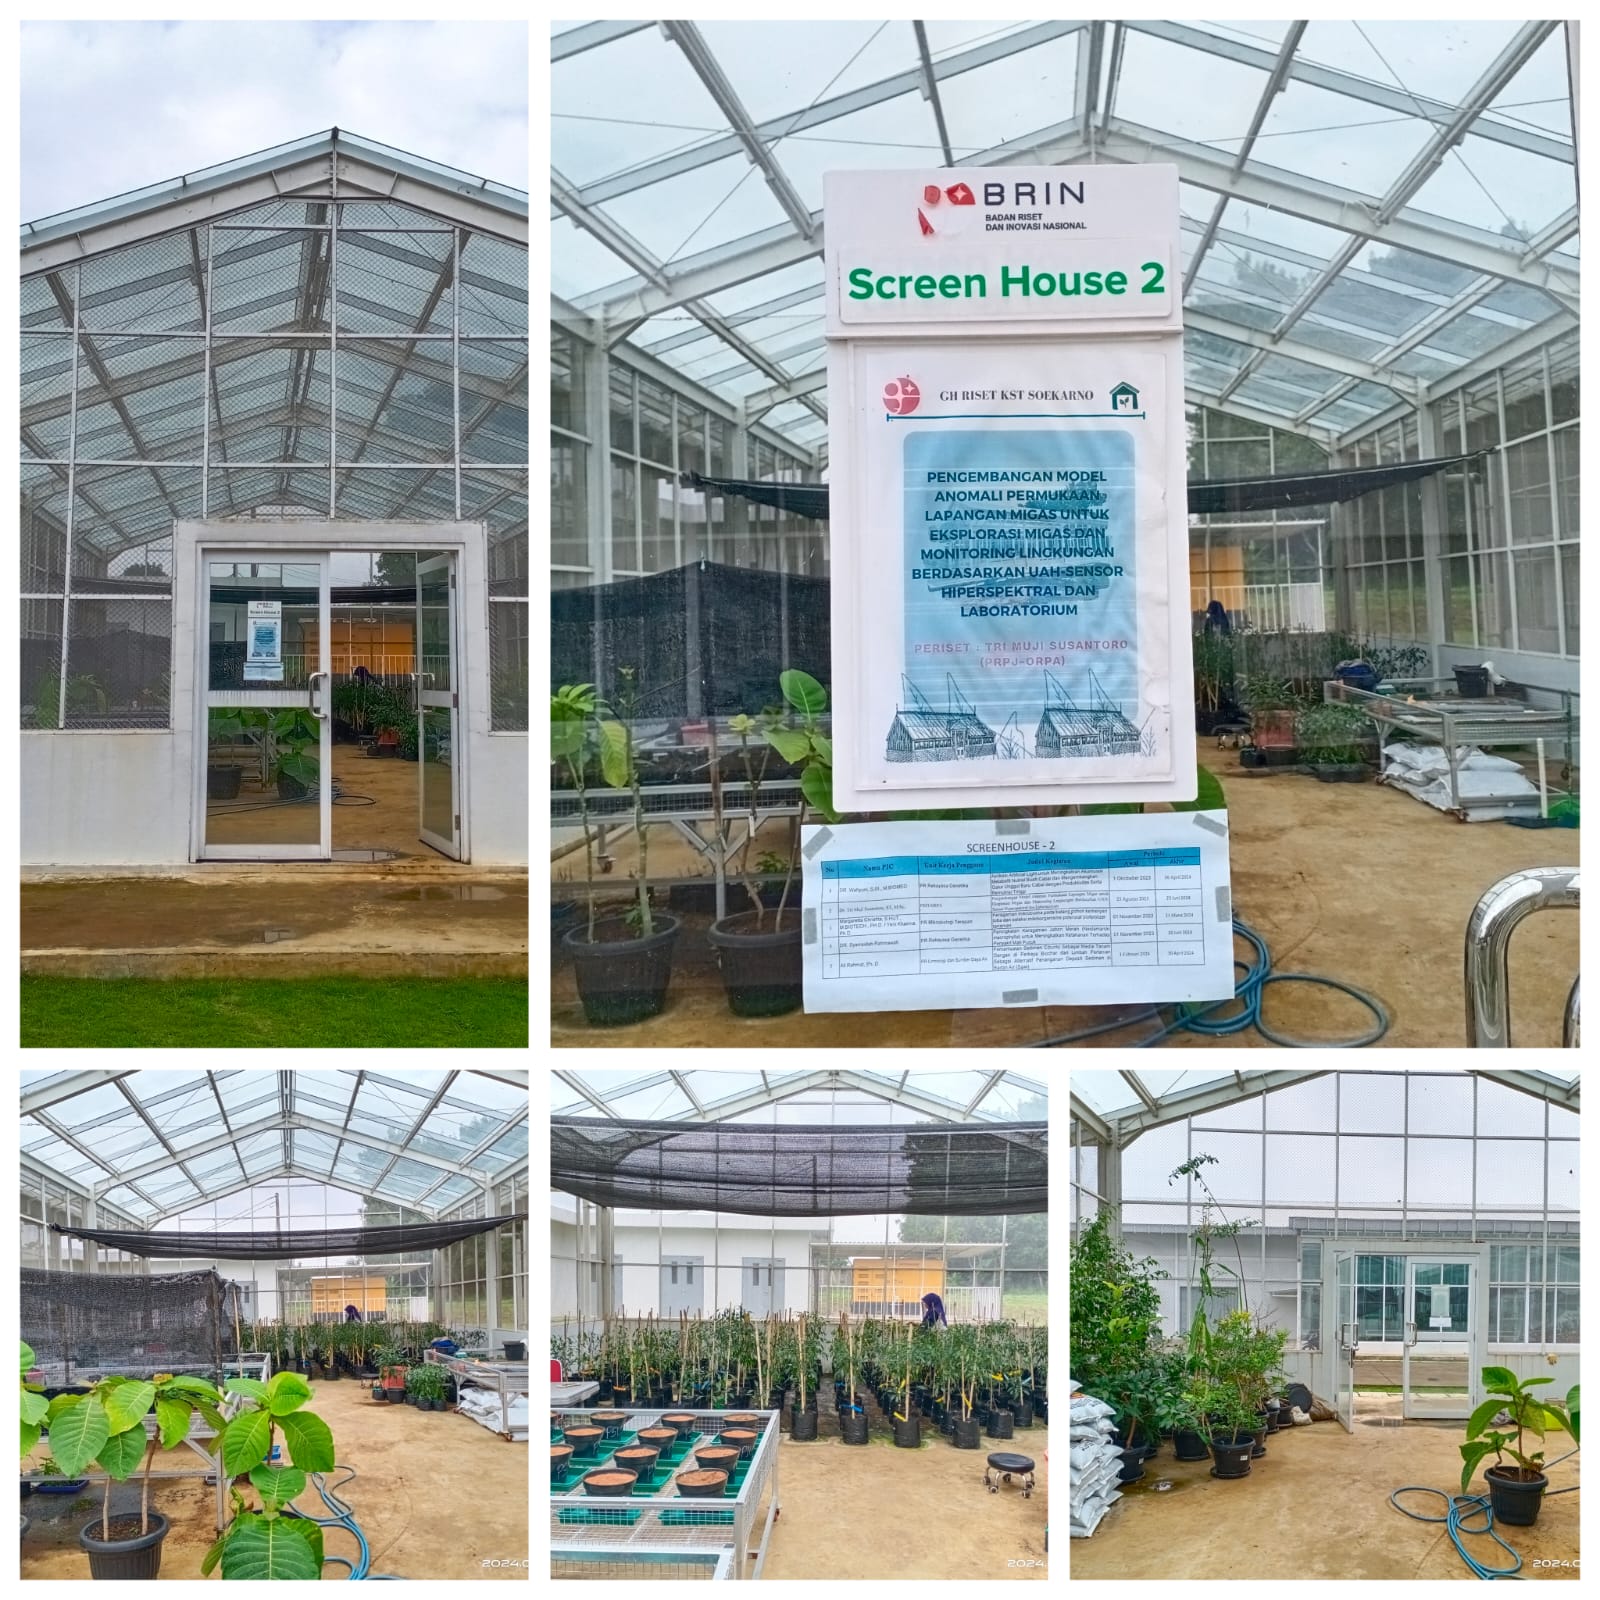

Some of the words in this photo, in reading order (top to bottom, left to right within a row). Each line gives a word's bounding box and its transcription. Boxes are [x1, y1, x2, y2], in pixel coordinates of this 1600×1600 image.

[984, 181, 1084, 205] BRIN
[985, 213, 1016, 222] BADAN
[1017, 212, 1043, 221] RISET
[985, 222, 1004, 232] DAN
[1005, 222, 1041, 231] INOVASI
[1043, 221, 1087, 231] NASIONAL
[848, 267, 986, 300] Screen
[1001, 264, 1127, 297] House
[1140, 261, 1165, 294] 2
[940, 390, 958, 401] GH
[962, 390, 997, 401] RISET
[1001, 390, 1025, 401] KST
[1027, 389, 1094, 401] SOEKARNO
[927, 471, 1053, 483] PENGEMBANGAN
[1056, 470, 1107, 482] MODEL
[934, 491, 1003, 502] ANOMALI
[1006, 490, 1100, 501] PERMUKAAN
[925, 510, 1006, 521] LAPANGAN
[1010, 509, 1057, 520] MIGAS
[1060, 508, 1110, 520] UNTUK
[929, 529, 1022, 540] EKSPLORASI
[1025, 528, 1071, 540] MIGAS
[1074, 527, 1106, 539] DAN
[920, 548, 1016, 560] MONITORING
[1019, 546, 1115, 558] LINGKUNGAN
[912, 567, 1025, 579] BERDASARKAN
[1028, 566, 1124, 577] UAH-SENSOR
[941, 586, 1061, 598] HIPERSPEKTRAL
[1065, 585, 1096, 596] DAN
[960, 605, 1078, 617] LABORATORIUM
[914, 643, 970, 653] PERISET
[985, 642, 1007, 652] TRI
[1011, 641, 1044, 652] MUJI
[1049, 640, 1128, 651] SUSANTORO
[980, 656, 1066, 668] (PRPJ-ORPA)
[967, 841, 1040, 853] SCREENHOUSE
[1049, 840, 1056, 850] 2
